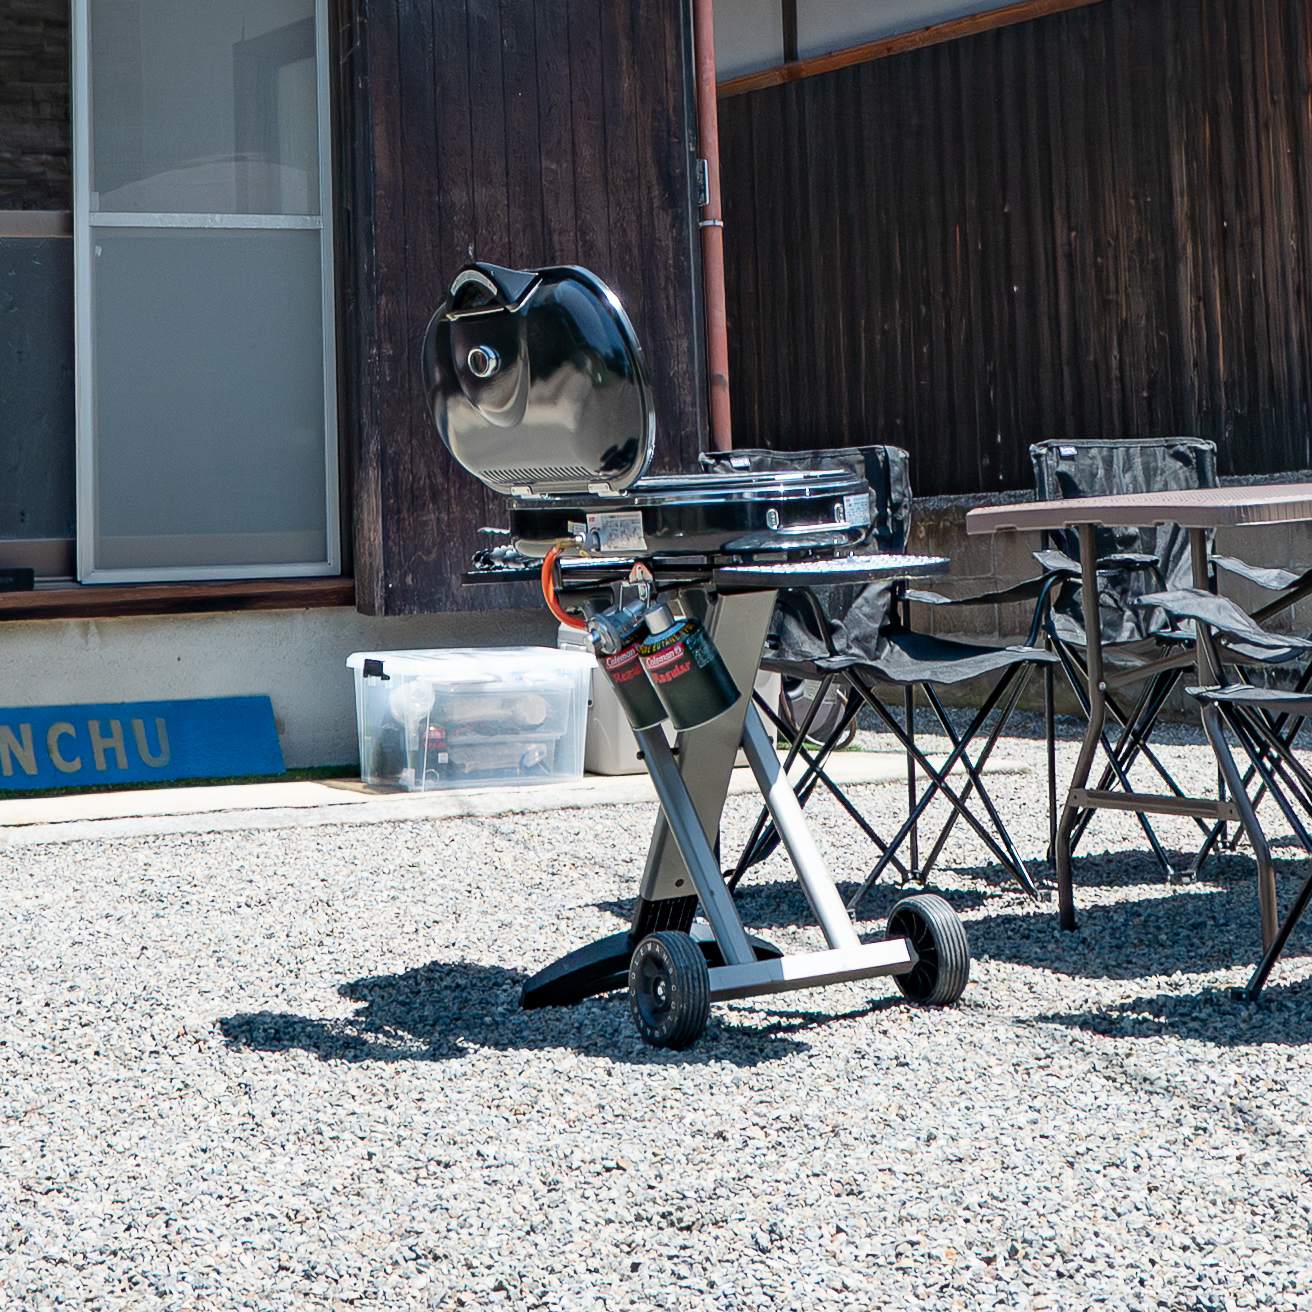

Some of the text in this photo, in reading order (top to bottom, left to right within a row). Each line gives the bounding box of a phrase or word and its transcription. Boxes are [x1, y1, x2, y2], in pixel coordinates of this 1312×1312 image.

[606, 648, 636, 667] Coleman
[645, 651, 675, 669] Coleman
[652, 661, 691, 684] Regular
